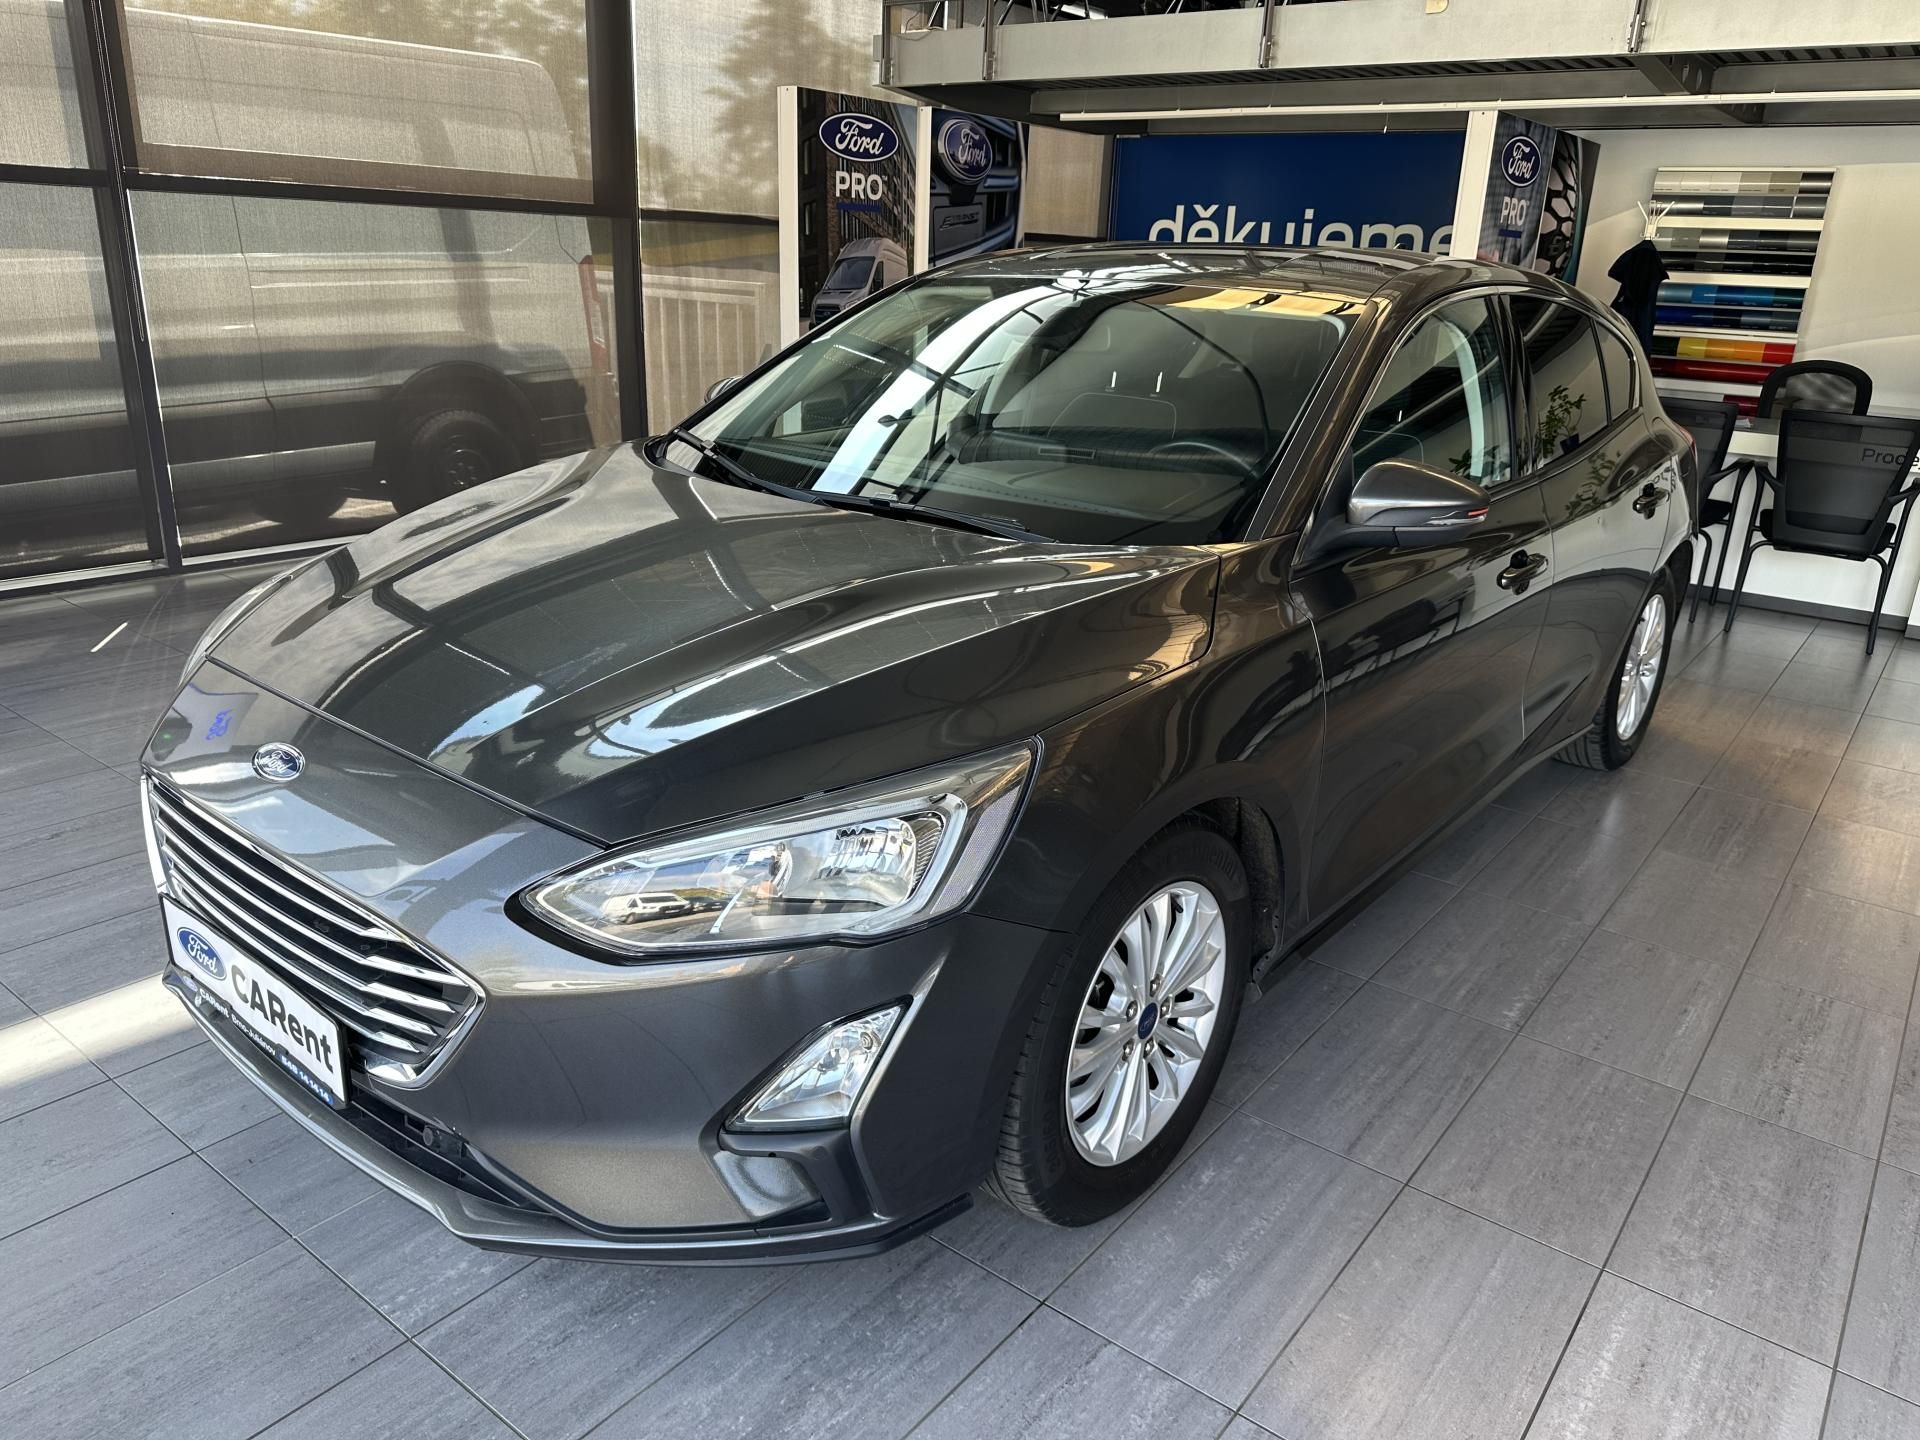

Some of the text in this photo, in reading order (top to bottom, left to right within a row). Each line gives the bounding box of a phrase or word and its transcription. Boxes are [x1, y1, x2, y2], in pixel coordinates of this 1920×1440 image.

[835, 118, 885, 155] Ford
[958, 128, 987, 167] Ford
[1508, 142, 1535, 179] Ford
[835, 170, 883, 201] PRO
[1500, 196, 1527, 226] PRO
[259, 750, 294, 774] Ford
[187, 934, 334, 1074] Ford CARent
